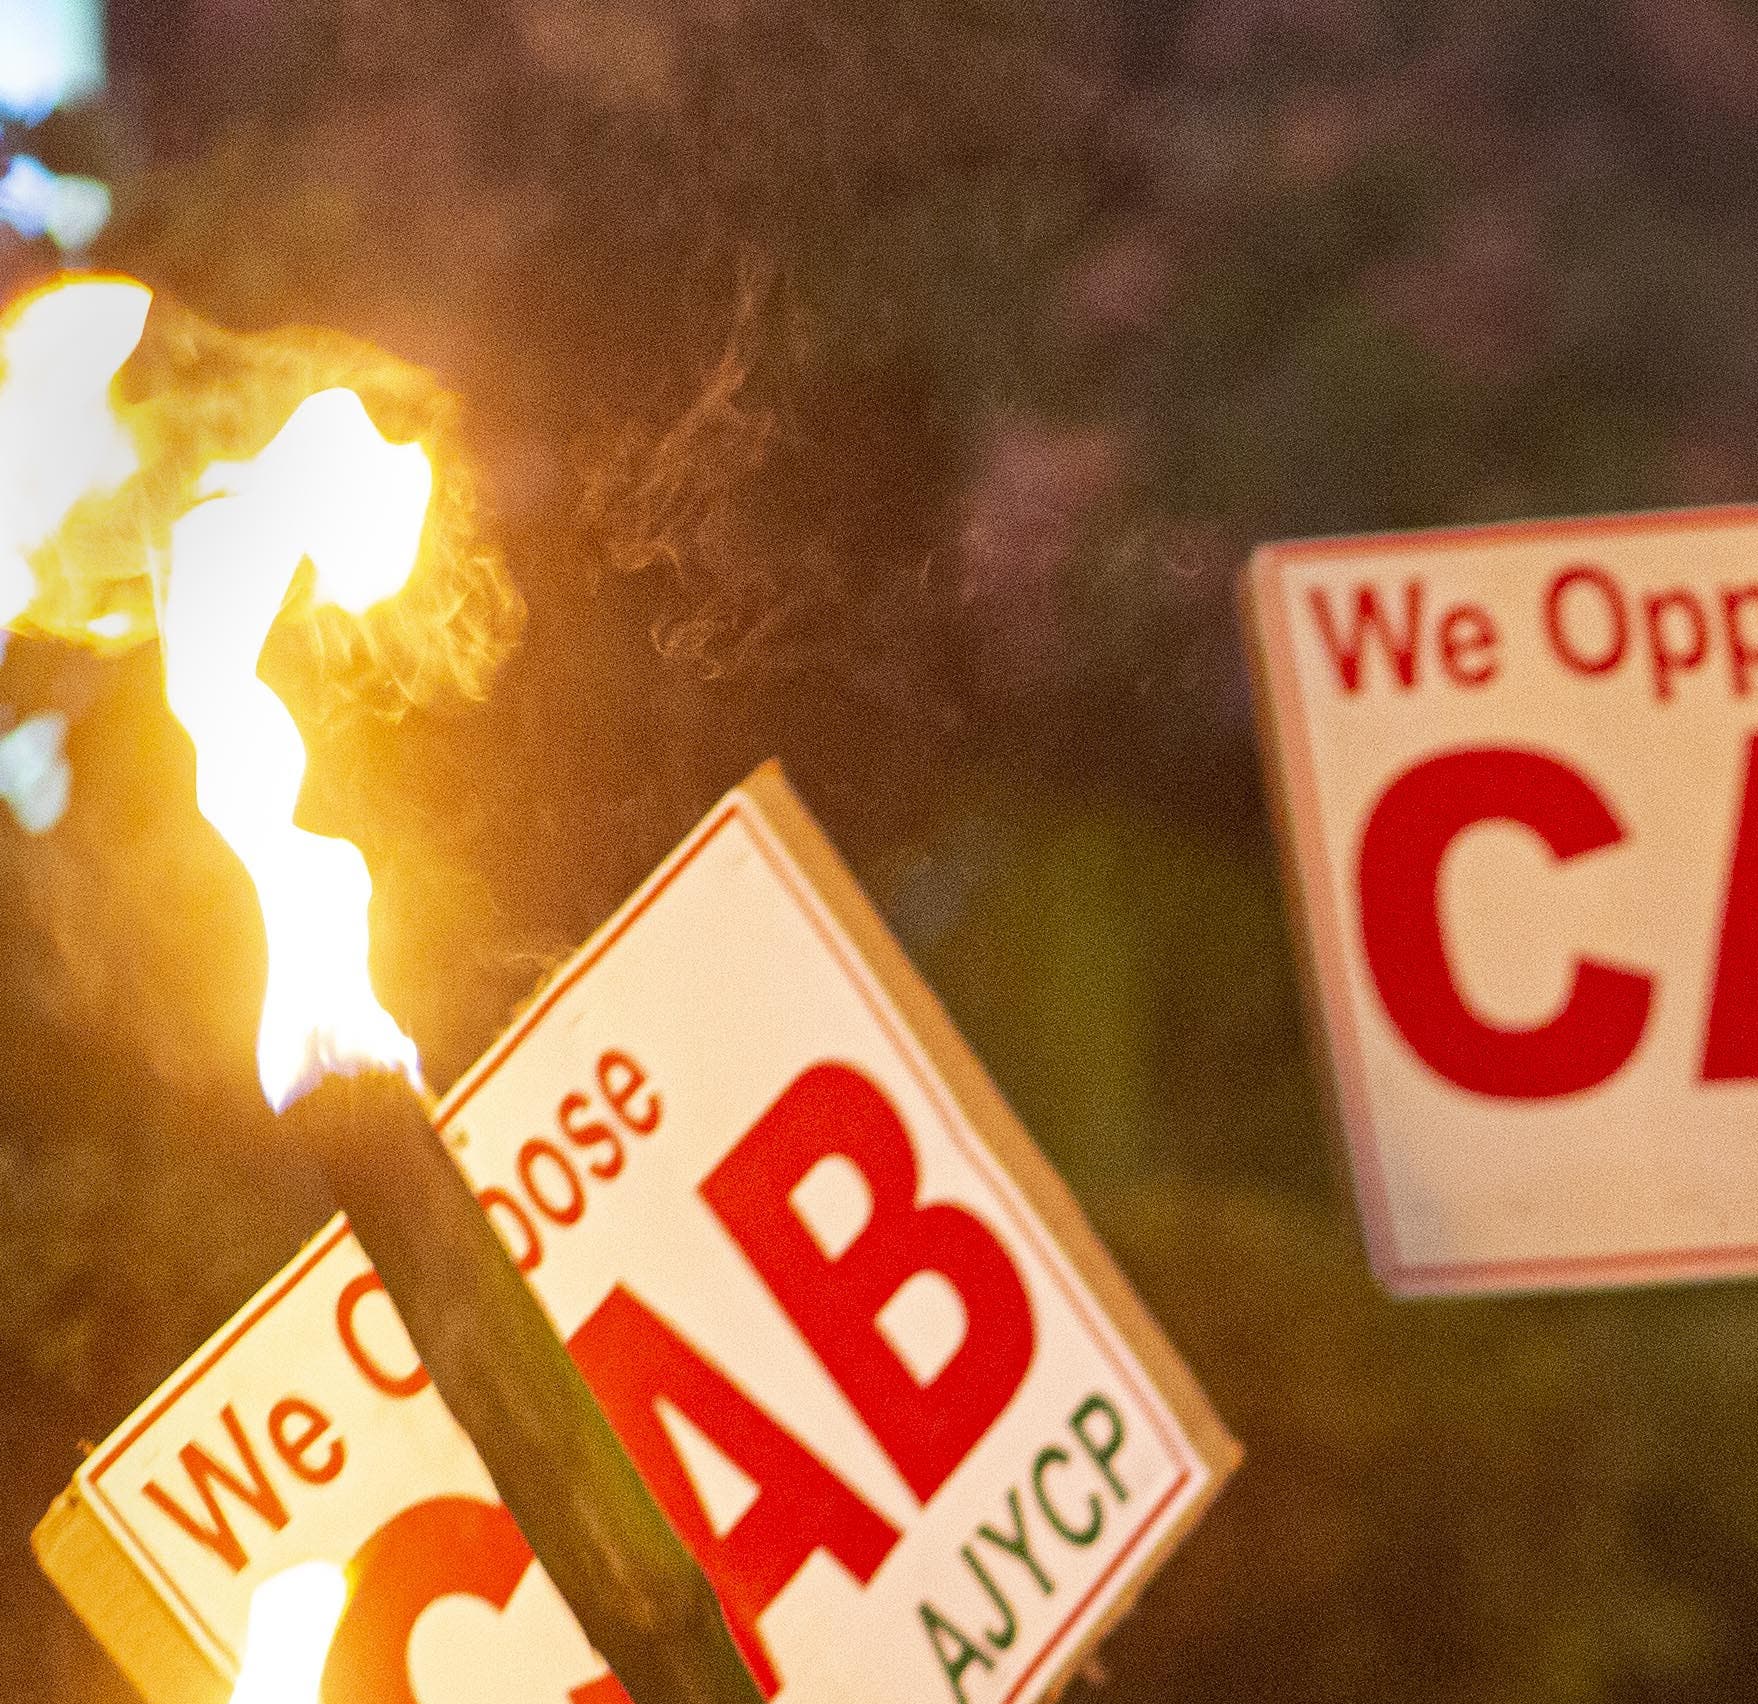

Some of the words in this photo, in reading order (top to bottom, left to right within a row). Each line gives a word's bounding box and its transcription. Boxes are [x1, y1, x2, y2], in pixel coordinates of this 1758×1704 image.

[1307, 579, 1501, 698] We
[141, 1396, 347, 1574] We
[335, 1047, 664, 1400] Oose
